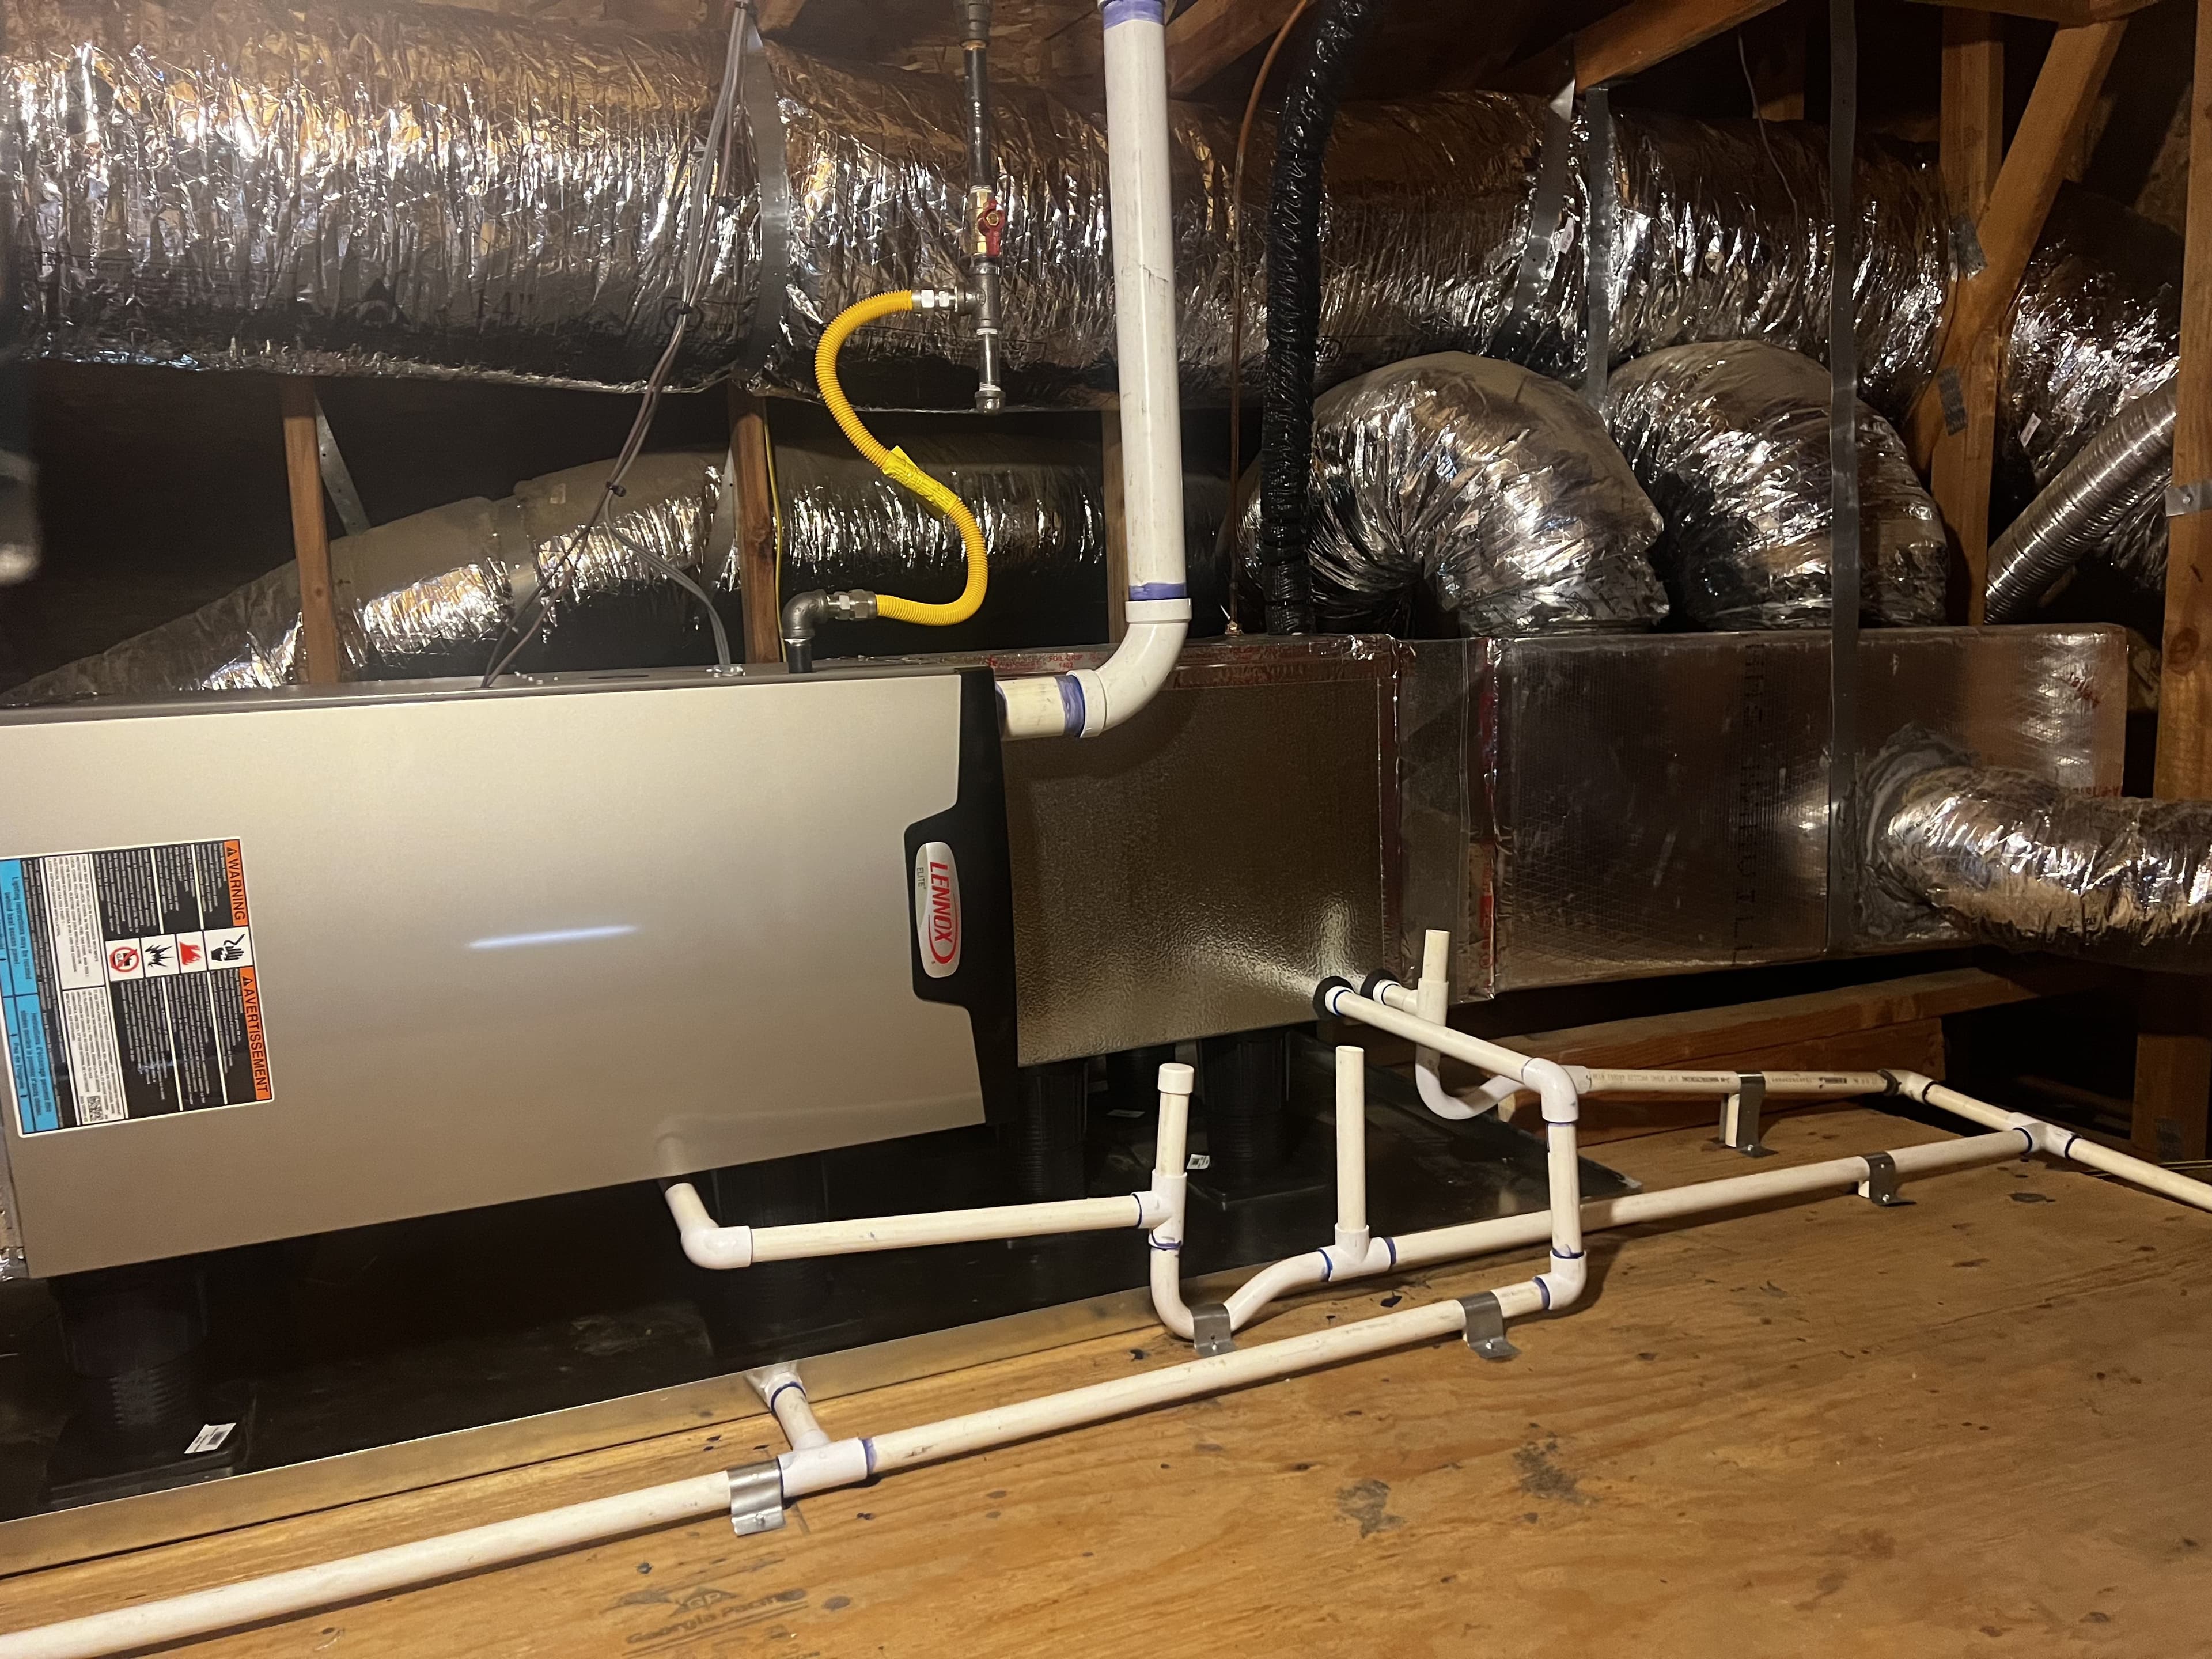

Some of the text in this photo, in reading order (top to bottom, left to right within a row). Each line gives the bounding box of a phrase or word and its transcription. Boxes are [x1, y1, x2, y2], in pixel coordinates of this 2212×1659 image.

[226, 858, 246, 921] WARNING
[916, 866, 925, 888] ELITE
[930, 861, 953, 942] LENNOX
[243, 987, 268, 1094] AVERTISSEMENT
